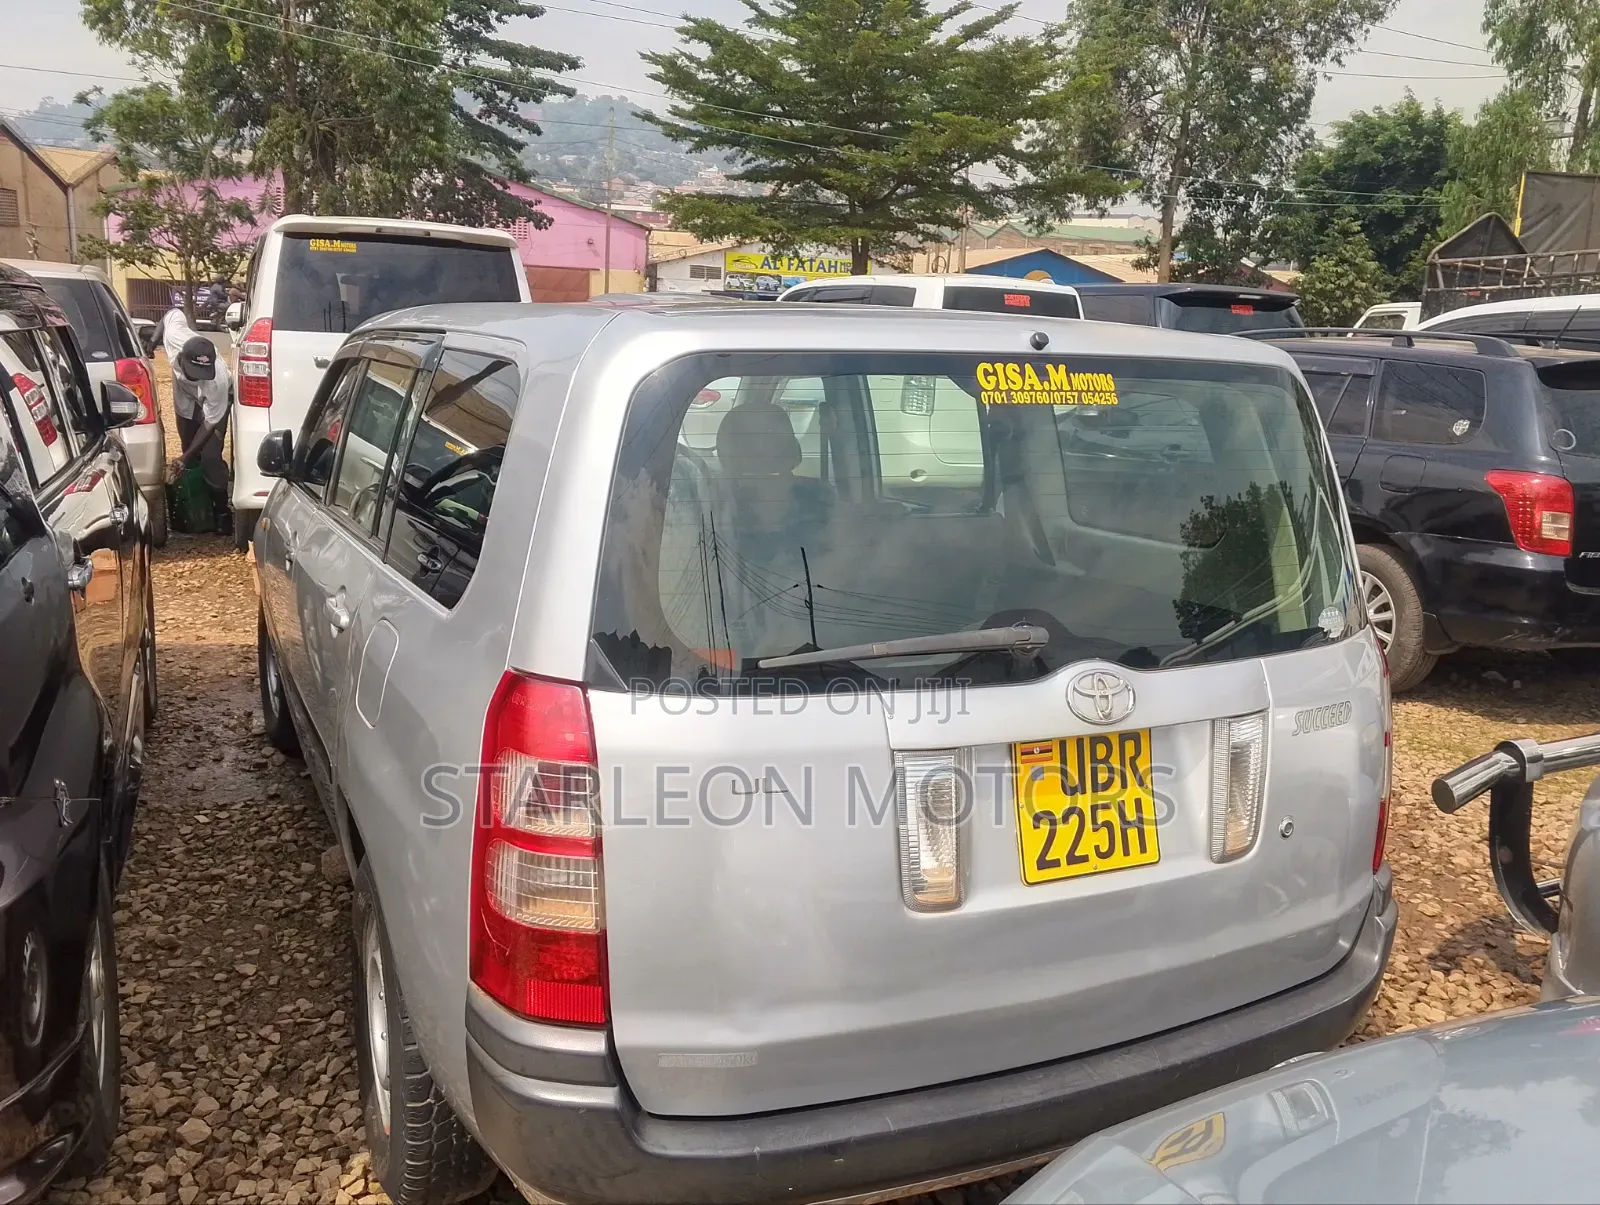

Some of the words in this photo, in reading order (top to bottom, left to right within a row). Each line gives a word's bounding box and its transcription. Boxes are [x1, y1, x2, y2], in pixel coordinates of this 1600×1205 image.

[309, 238, 341, 248] GISA.M
[787, 258, 838, 274] FATAH
[976, 361, 1070, 391] GISA.M
[1070, 372, 1116, 392] MOTORS
[980, 391, 1008, 404] 0701
[1082, 391, 1119, 405] 054256
[1292, 700, 1352, 737] SUCCEED
[1059, 731, 1146, 797] UBR
[1032, 797, 1148, 872] 225H
